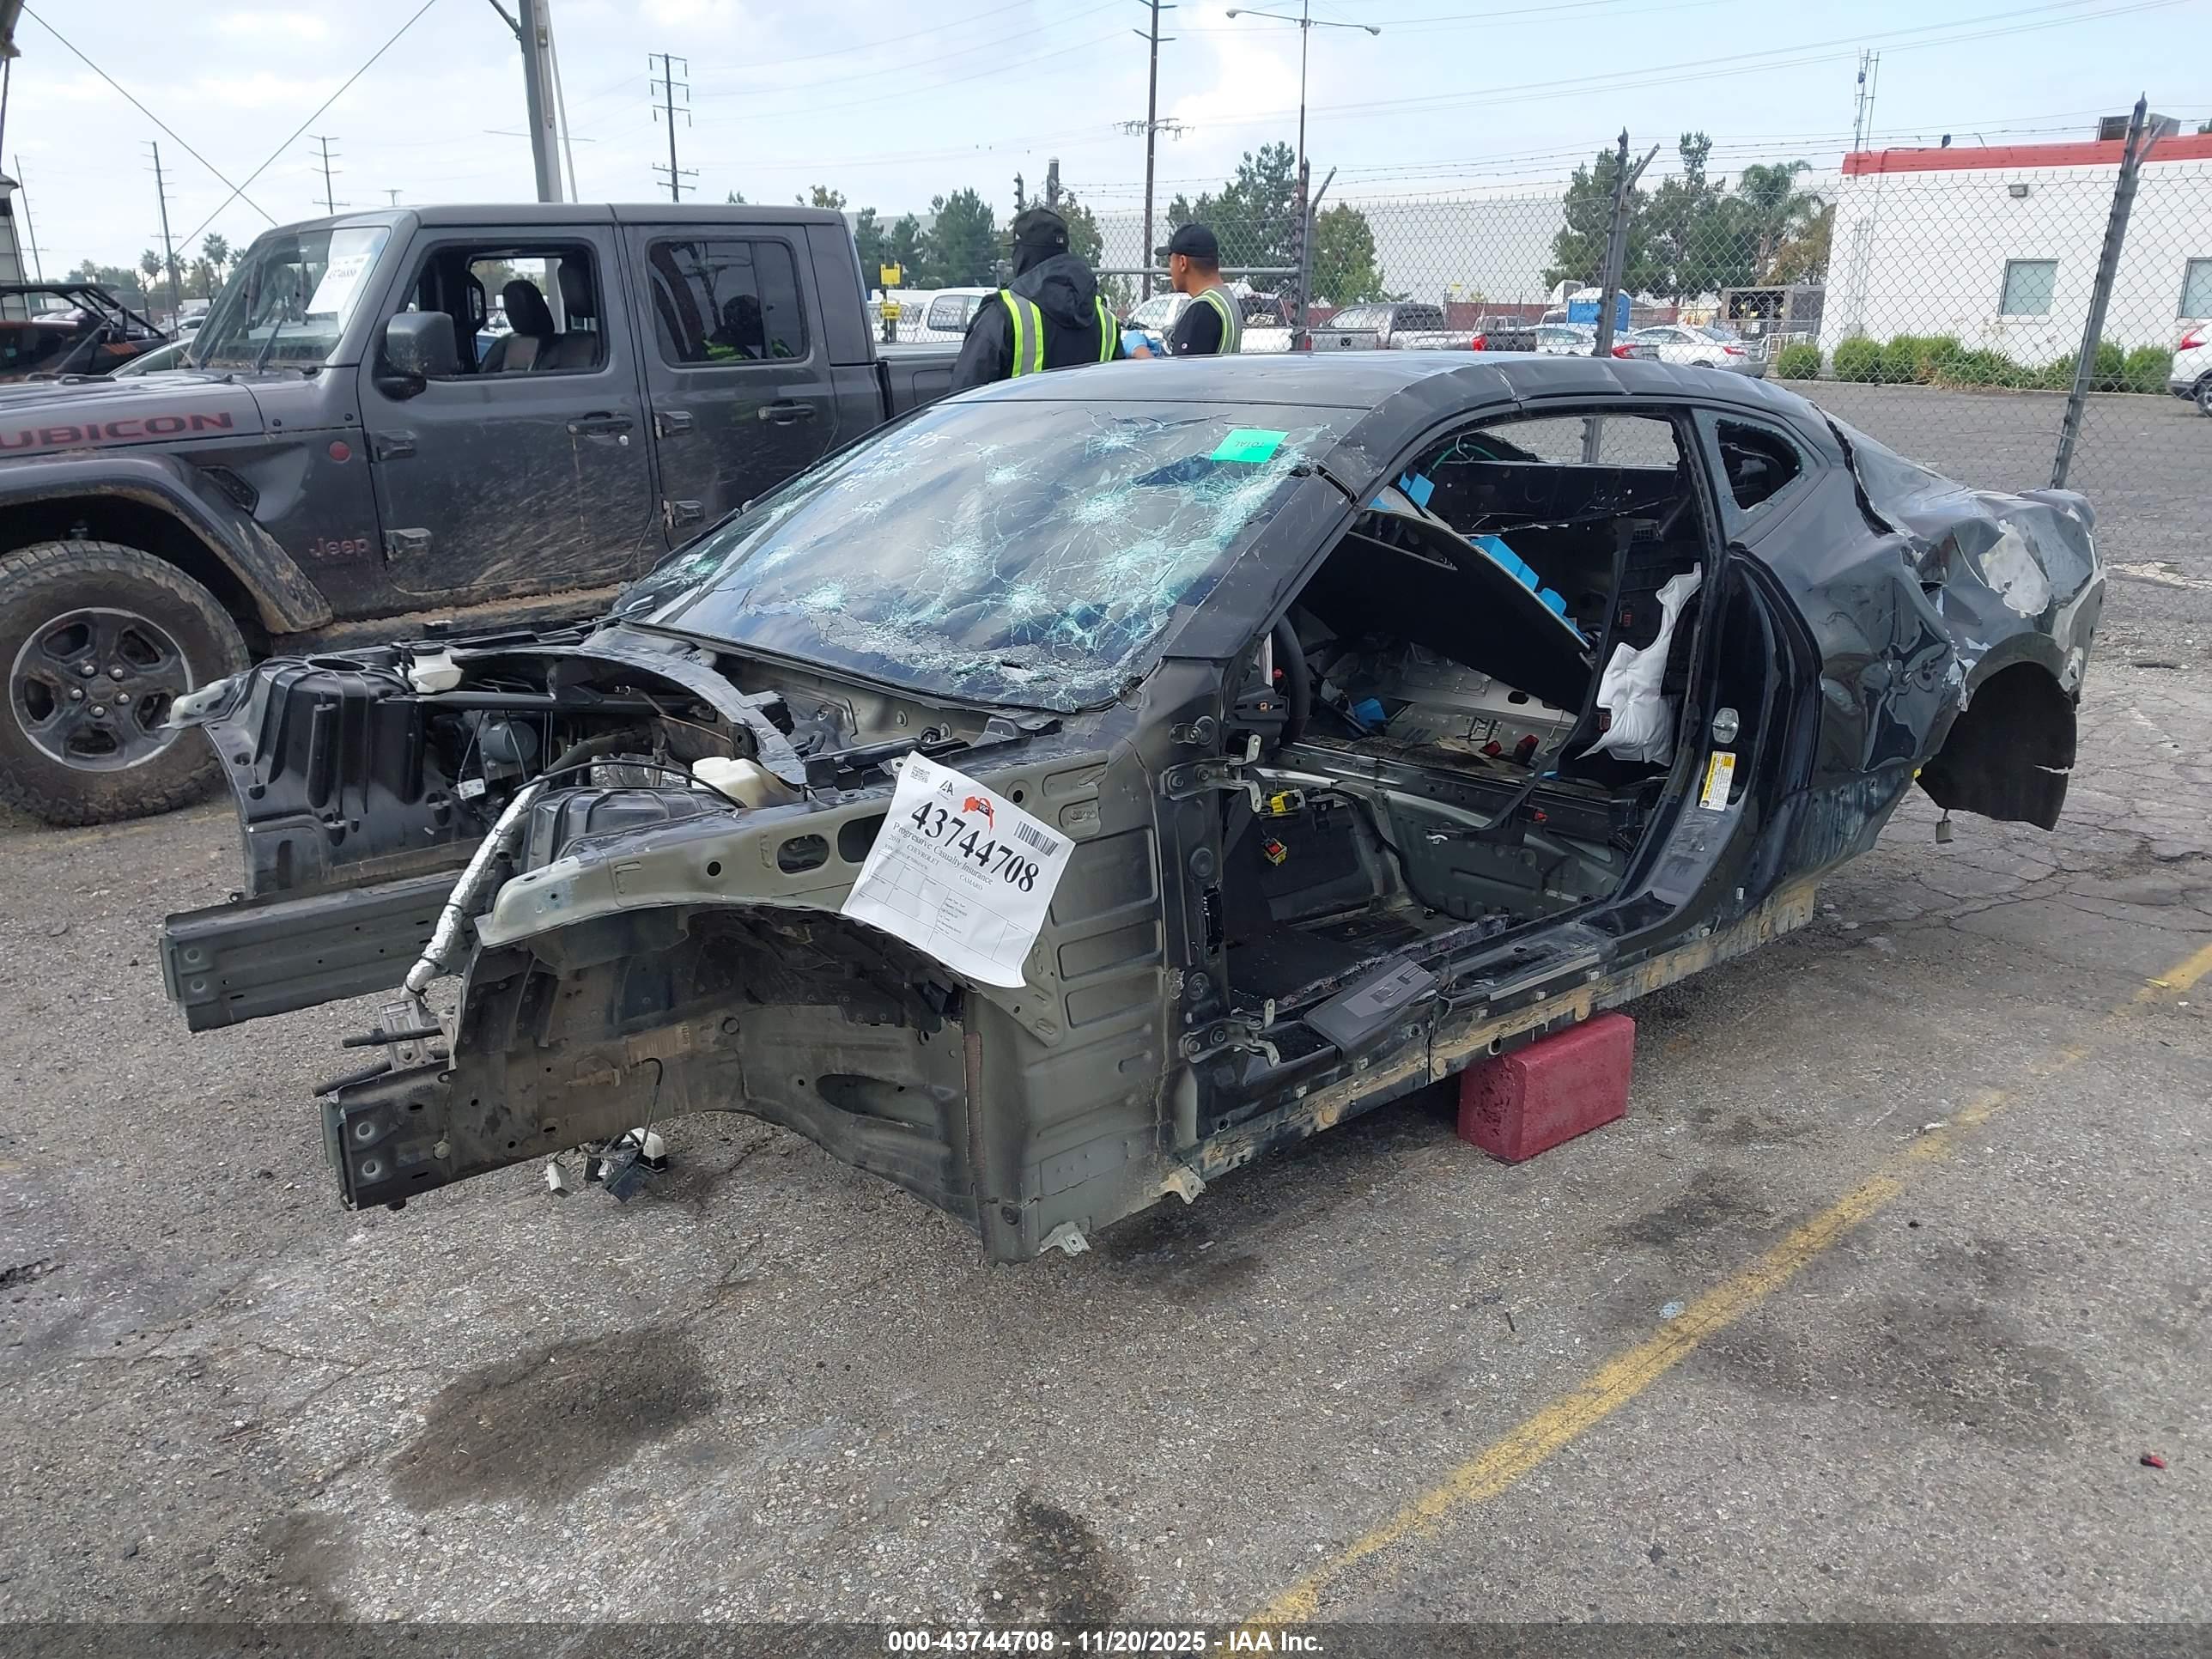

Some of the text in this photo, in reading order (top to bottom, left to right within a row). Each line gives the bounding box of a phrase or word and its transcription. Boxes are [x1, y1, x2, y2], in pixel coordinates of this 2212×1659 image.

[309, 538, 371, 558] Jeep
[893, 821, 933, 850] Progressive
[933, 845, 960, 867] Casualty
[962, 860, 994, 885] Insurance
[906, 845, 940, 867] CHEVROLET
[958, 874, 983, 890] CAMARO
[911, 800, 1039, 892] 43744708
